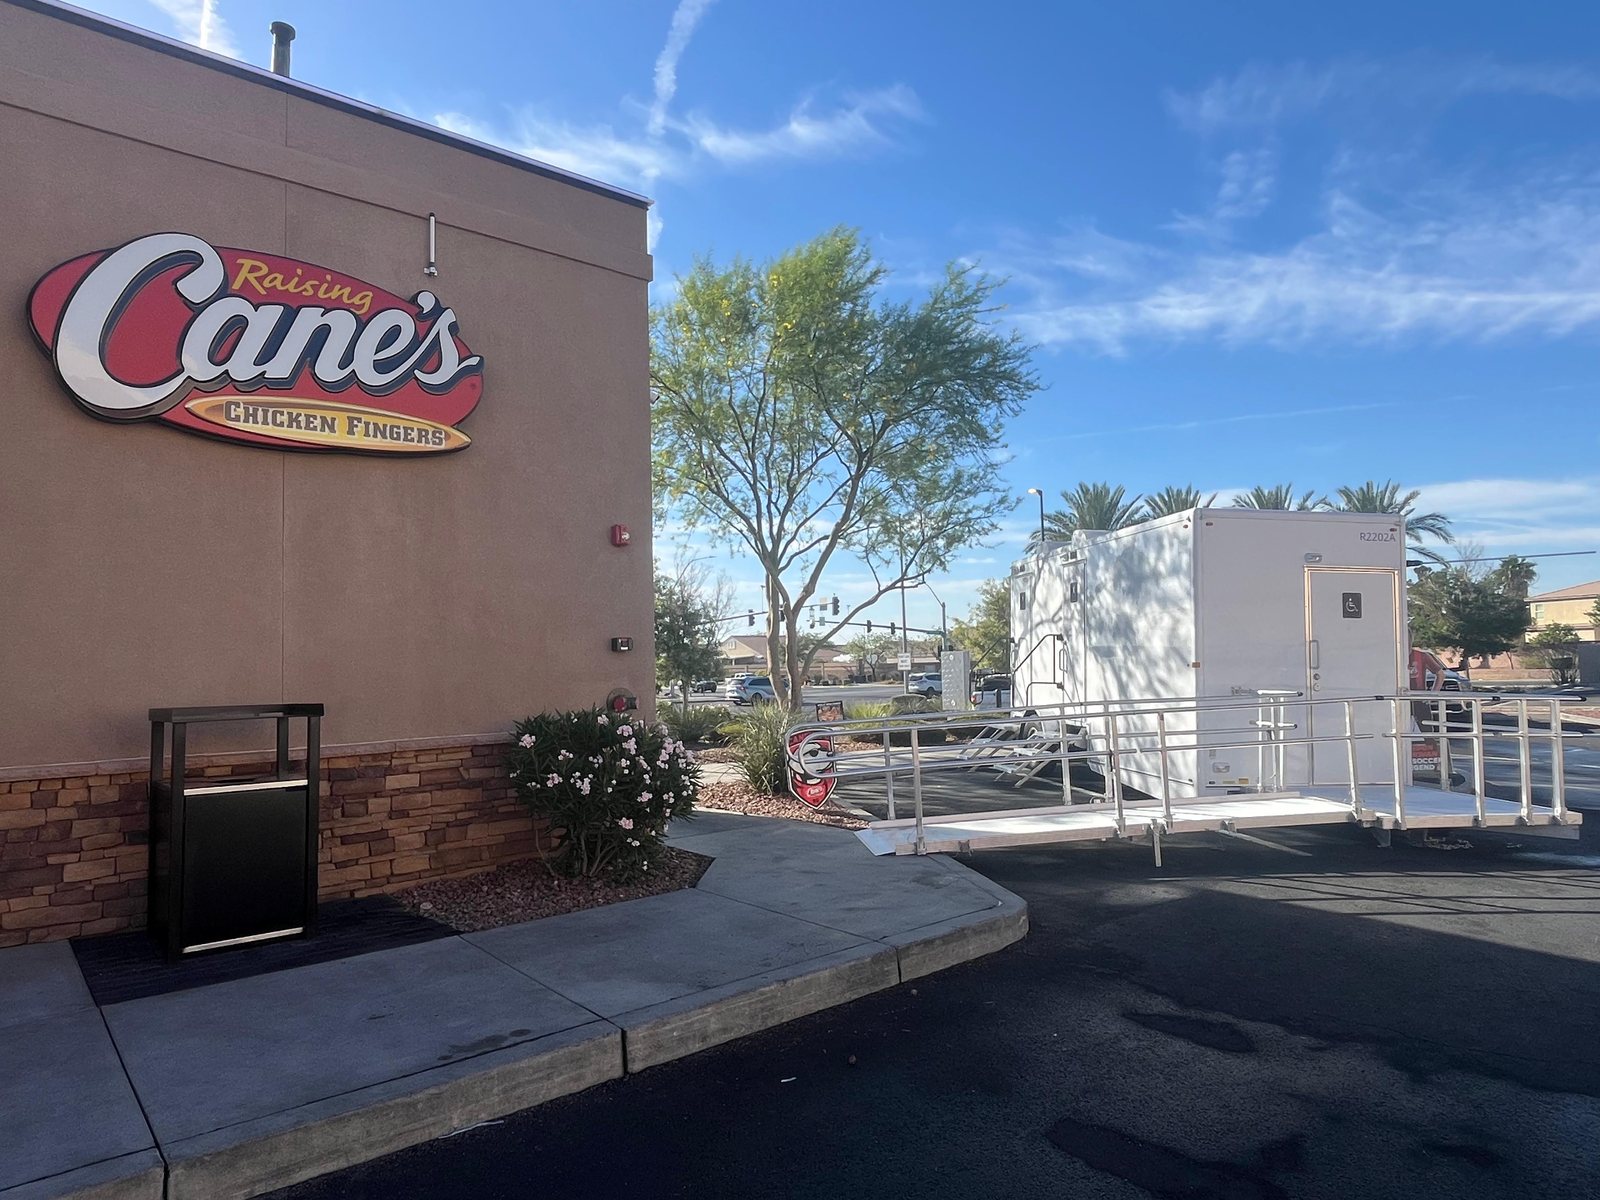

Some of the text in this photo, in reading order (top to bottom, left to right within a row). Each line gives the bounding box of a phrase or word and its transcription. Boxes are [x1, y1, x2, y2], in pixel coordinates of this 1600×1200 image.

[231, 258, 374, 315] Raising
[55, 232, 482, 409] Cane's
[1359, 532, 1396, 542] R2202A
